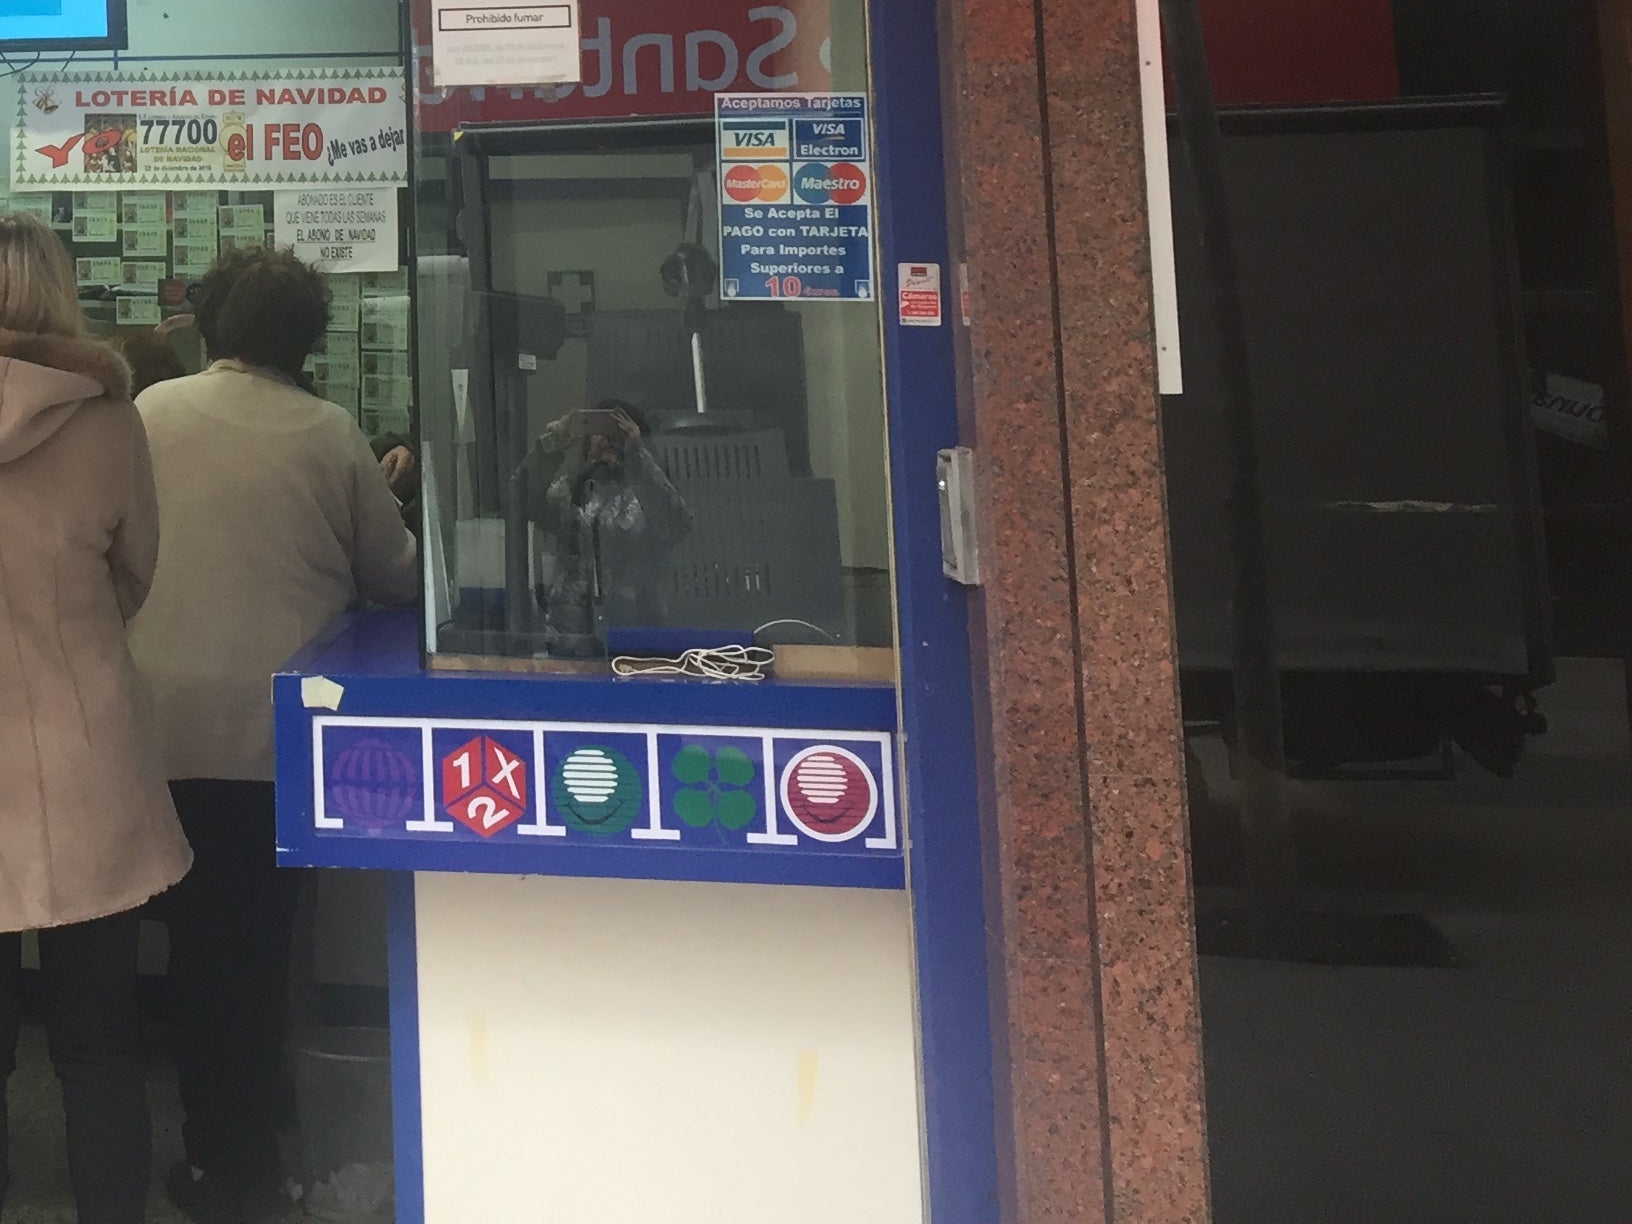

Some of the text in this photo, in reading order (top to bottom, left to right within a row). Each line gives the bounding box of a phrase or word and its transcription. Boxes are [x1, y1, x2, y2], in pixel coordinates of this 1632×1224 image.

[465, 11, 544, 24] Prohibido fumar
[75, 86, 387, 107] LOTERÍA DE NAVIDAD
[721, 97, 861, 110] Aceptamos Tarjetas
[139, 118, 218, 145] 77700
[812, 123, 845, 135] VISA
[227, 123, 324, 162] el FEO
[349, 135, 368, 156] vas
[369, 135, 377, 151] a
[378, 126, 405, 152] dejar
[734, 132, 777, 147] VISA
[800, 145, 859, 156] Electron
[726, 178, 786, 190] MasterCard
[800, 176, 860, 191] Maestro
[744, 208, 839, 221] Se Acepta El
[296, 229, 305, 242] EL
[334, 229, 344, 241] DE
[723, 225, 868, 237] PAGO con TARJETA
[741, 244, 846, 258] Para Importes
[750, 263, 844, 275] Superiores a
[765, 276, 802, 297] 10
[452, 751, 471, 789] 1
[492, 746, 521, 800] X
